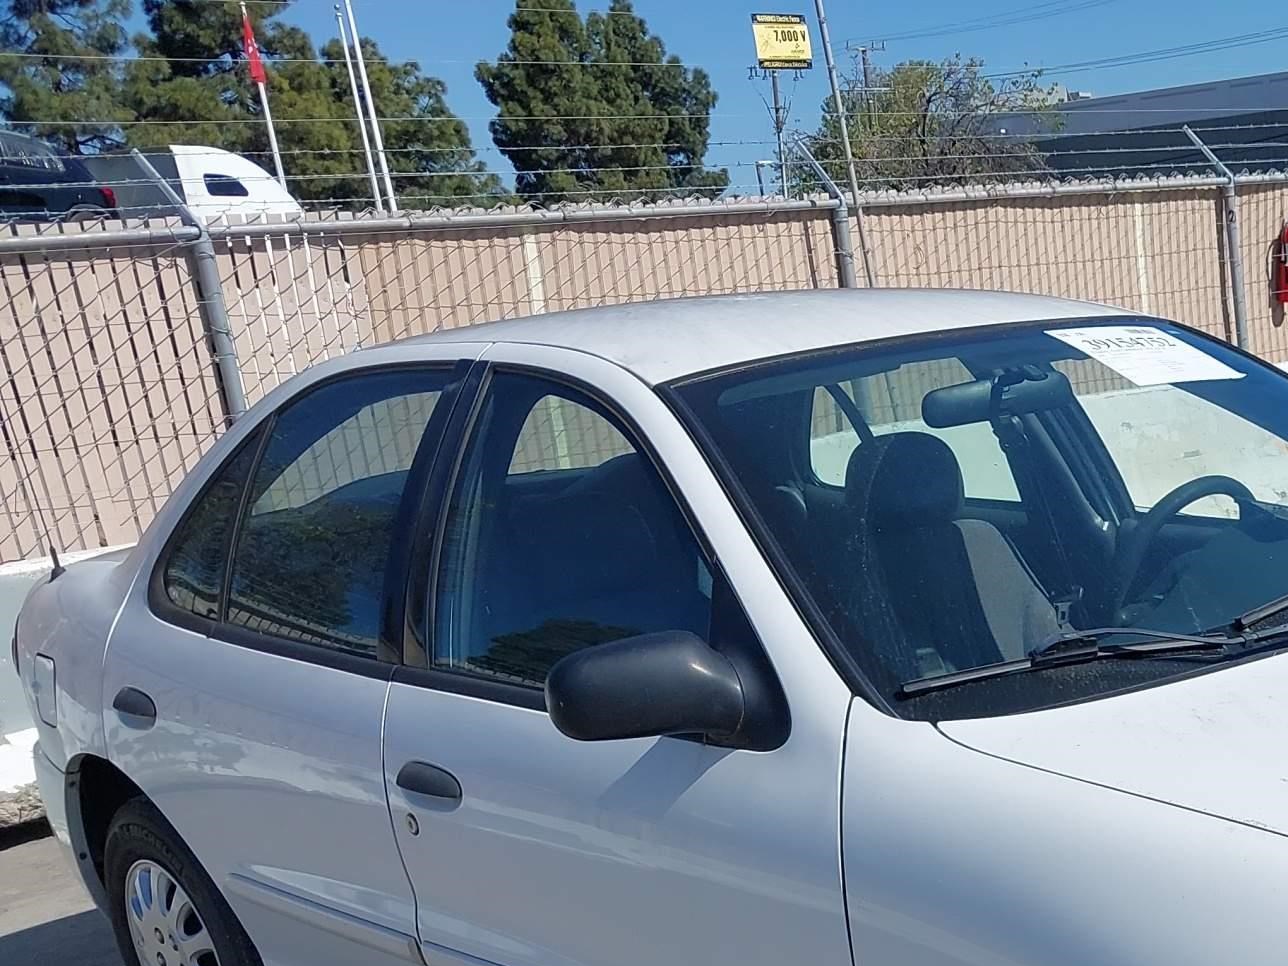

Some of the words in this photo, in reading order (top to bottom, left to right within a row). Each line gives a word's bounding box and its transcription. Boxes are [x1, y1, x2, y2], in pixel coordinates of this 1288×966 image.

[773, 30, 799, 44] 7,000
[799, 30, 806, 42] V
[1081, 337, 1177, 351] 39154752
